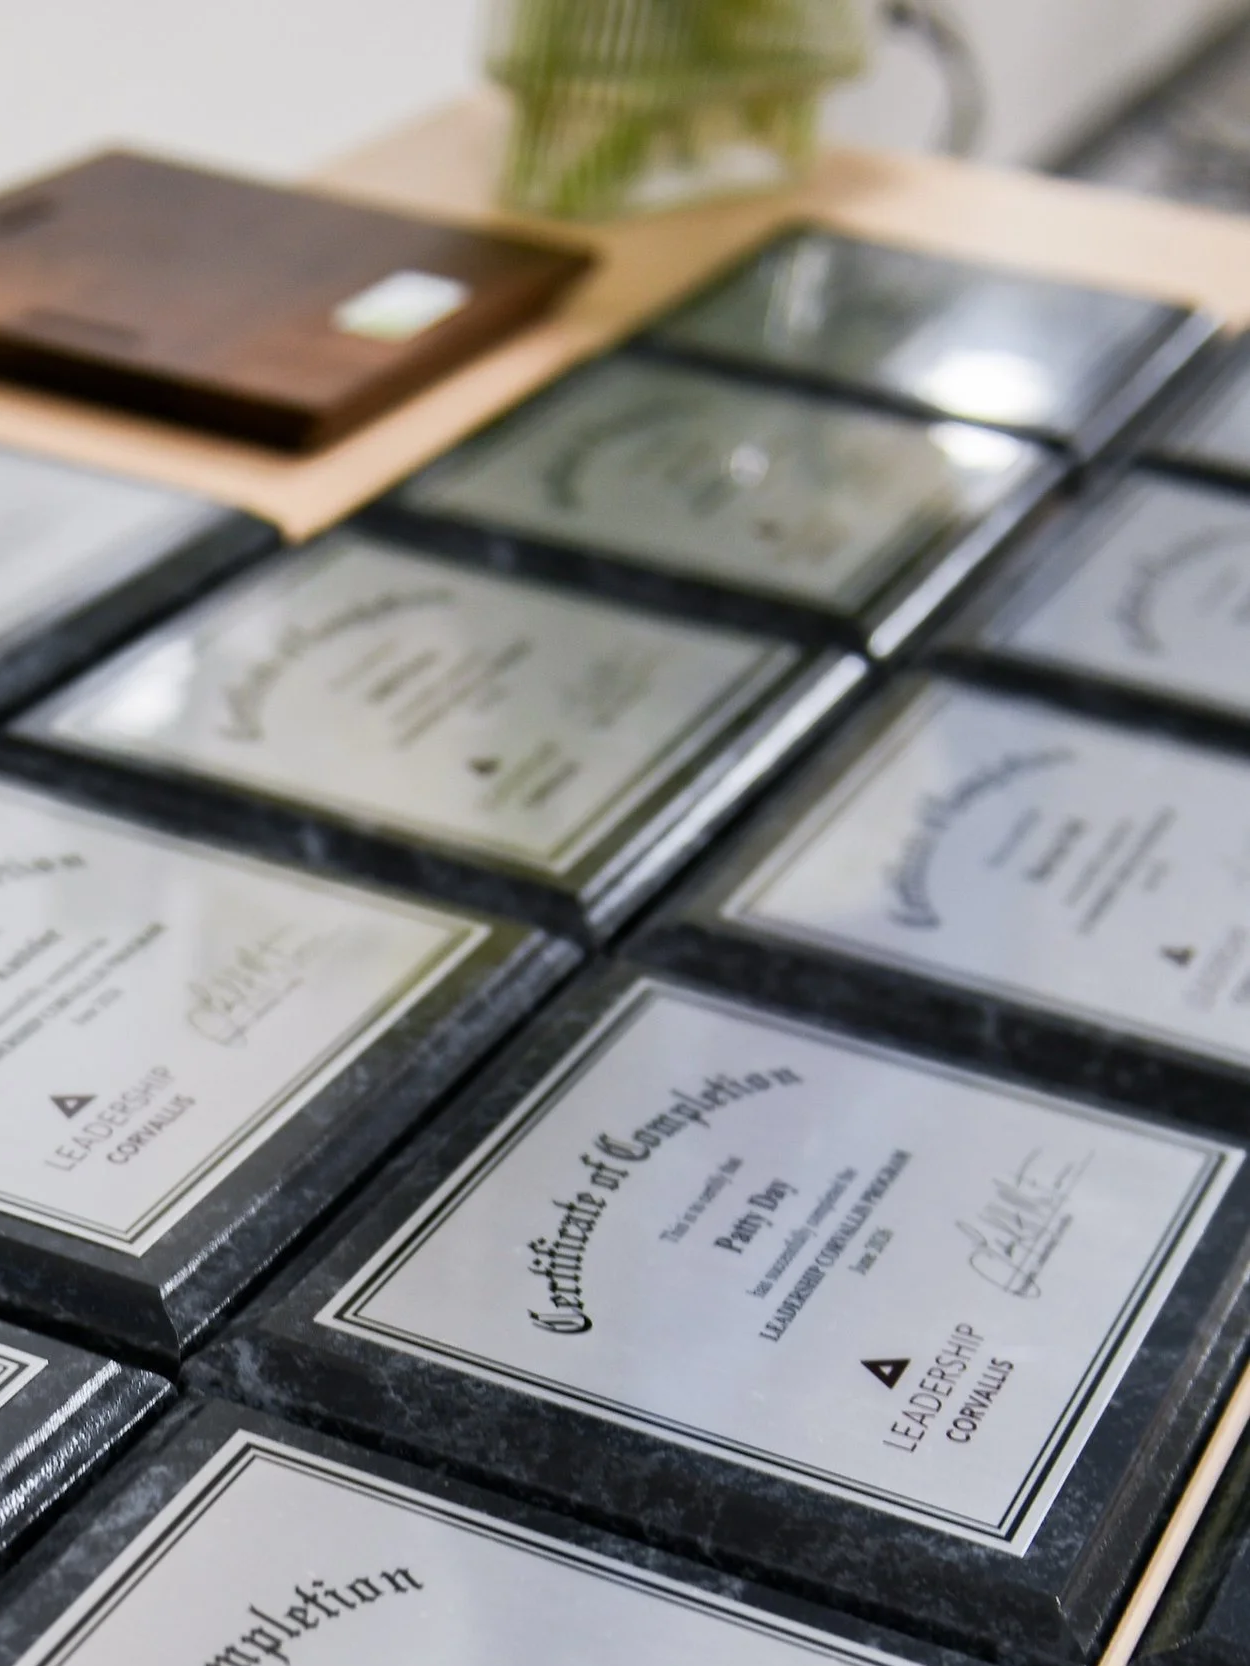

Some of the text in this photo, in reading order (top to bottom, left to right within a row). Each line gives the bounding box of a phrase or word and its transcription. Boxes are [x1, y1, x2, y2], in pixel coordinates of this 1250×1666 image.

[44, 1064, 175, 1172] LEADERSHIP
[106, 1093, 197, 1166] CORVALLIS
[528, 1065, 804, 1335] Certificate of Completion
[713, 1177, 799, 1255] Patty Day
[759, 1265, 826, 1343] LEADERSHIP
[882, 1322, 986, 1454] LEADERSHIP
[946, 1357, 1015, 1445] CORVALLIS
